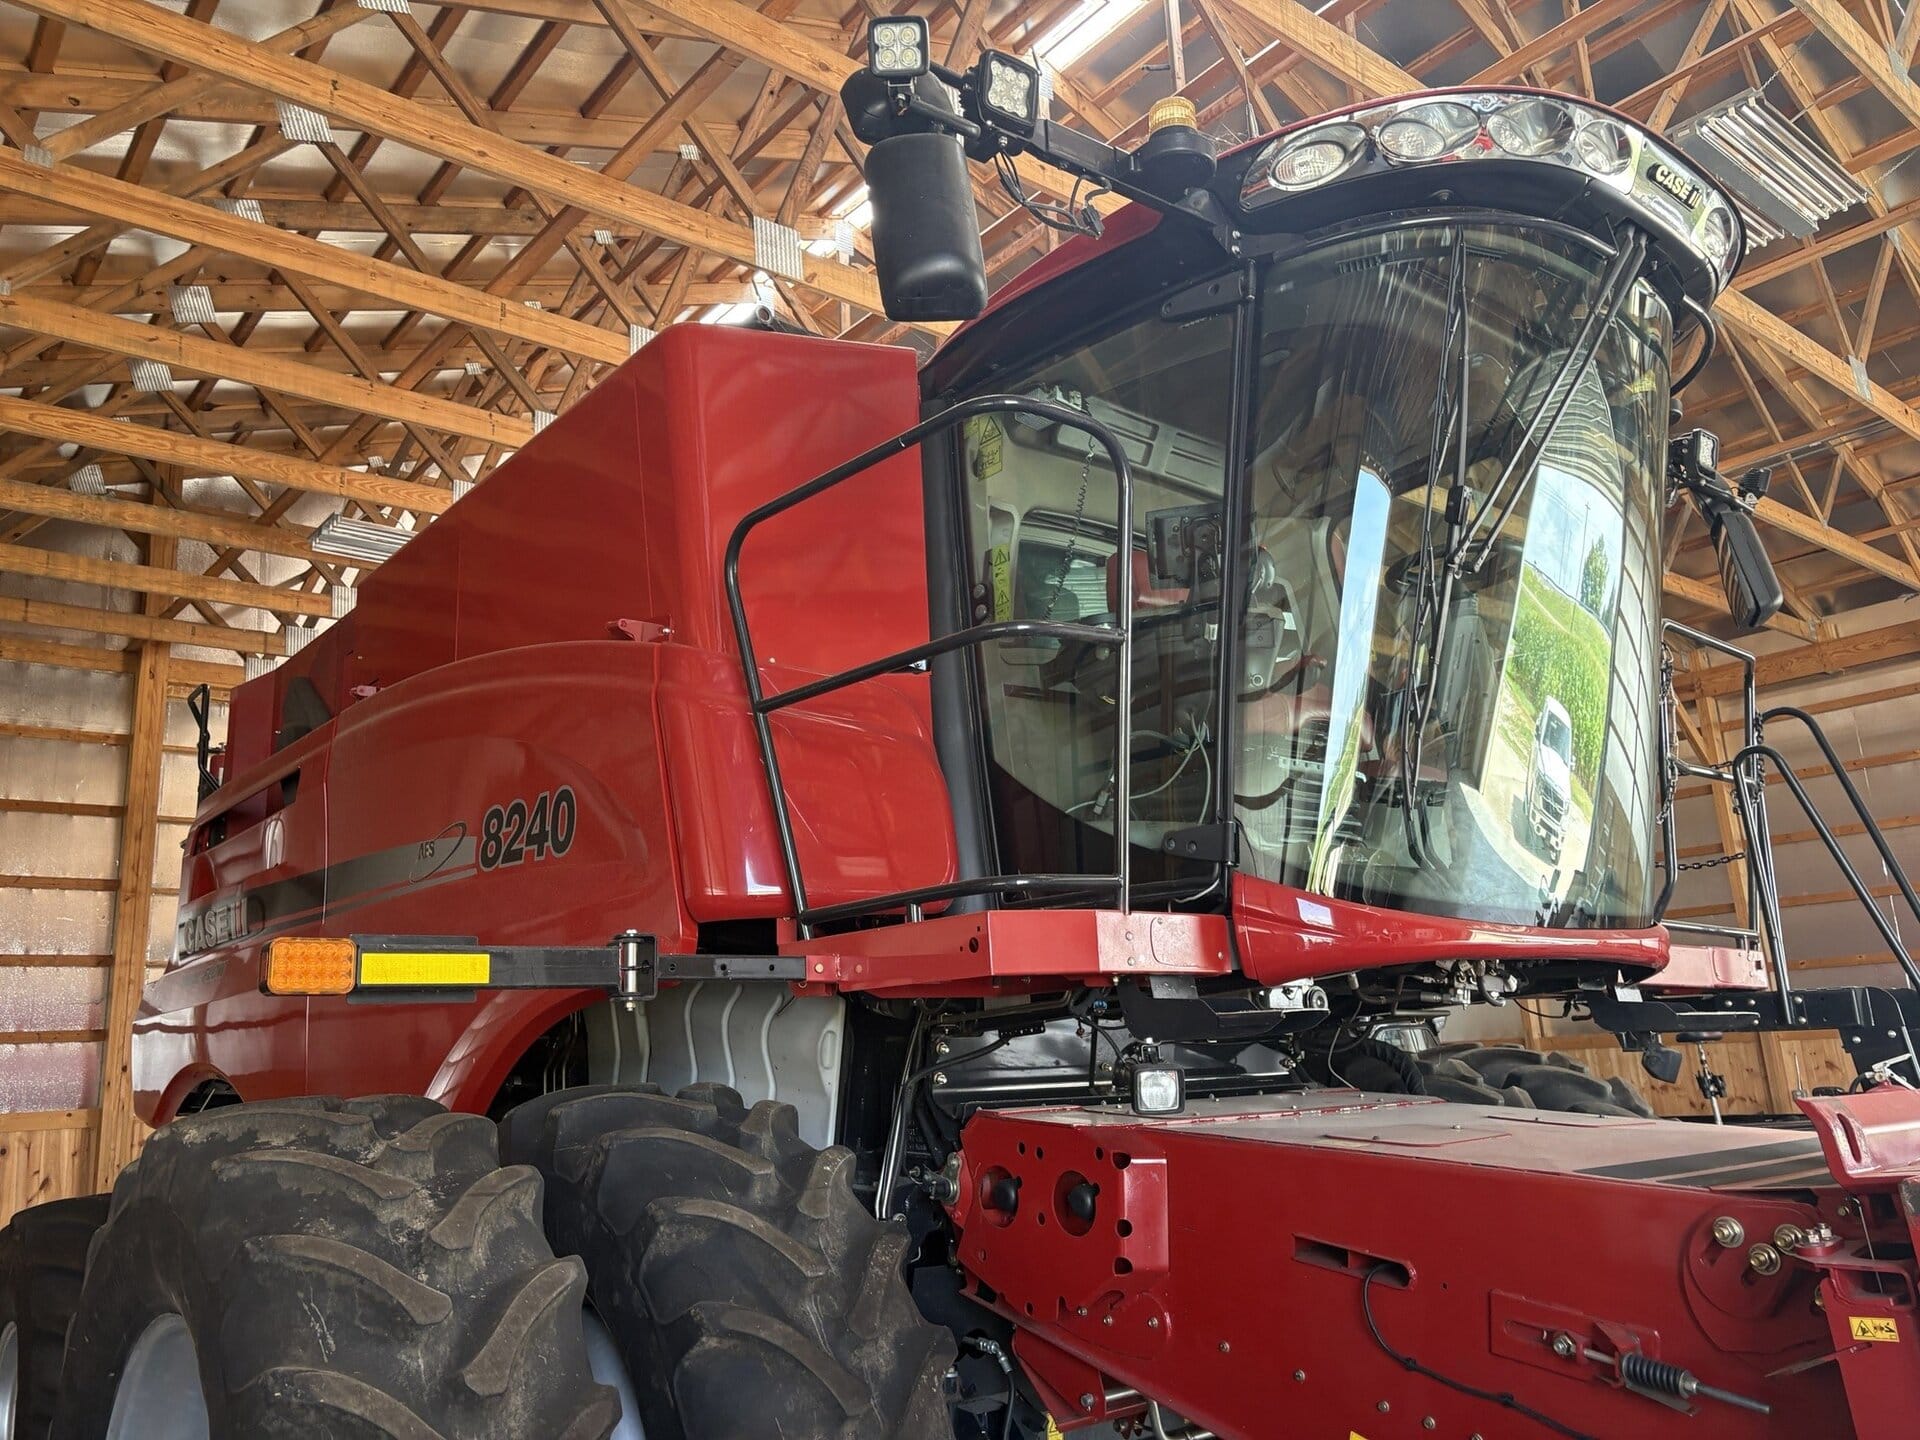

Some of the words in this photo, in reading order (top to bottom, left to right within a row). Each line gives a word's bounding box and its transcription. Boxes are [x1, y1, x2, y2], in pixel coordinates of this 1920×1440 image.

[1655, 165, 1692, 201] CASE
[480, 785, 577, 872] 8240
[183, 906, 229, 955] CASE
